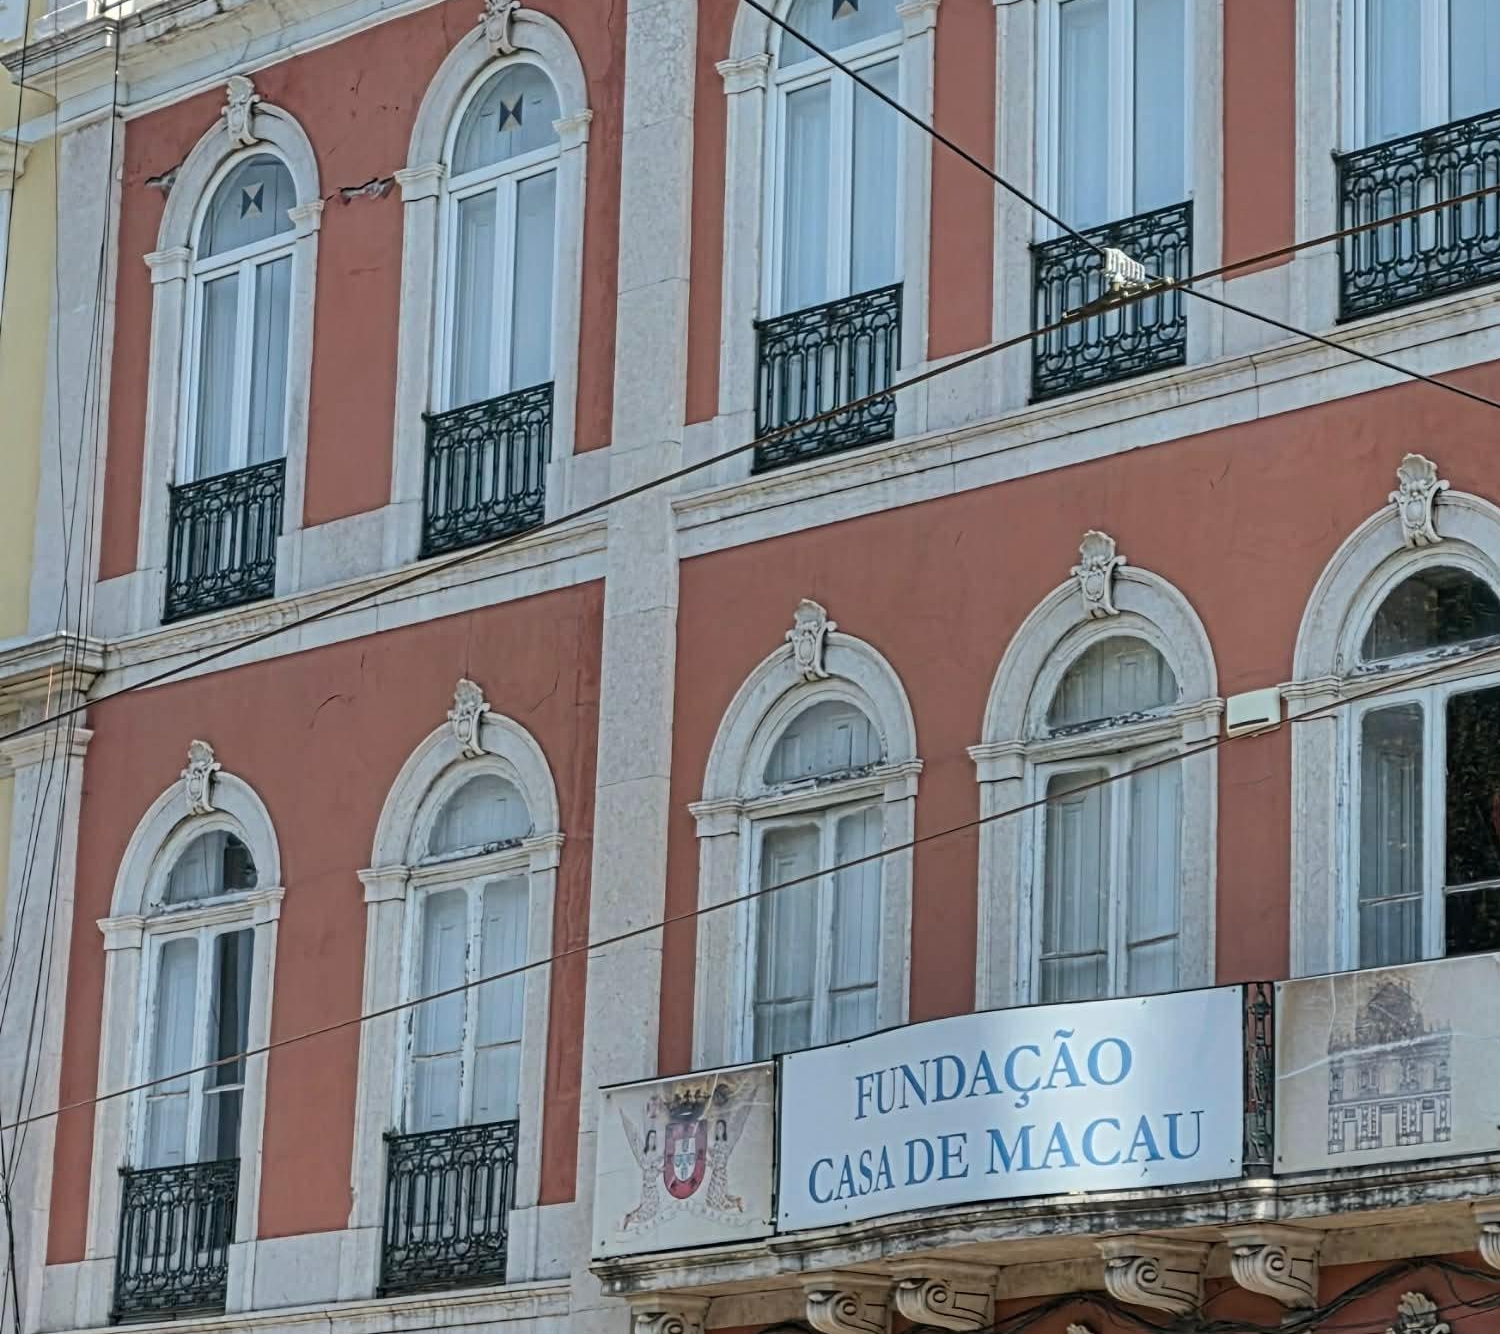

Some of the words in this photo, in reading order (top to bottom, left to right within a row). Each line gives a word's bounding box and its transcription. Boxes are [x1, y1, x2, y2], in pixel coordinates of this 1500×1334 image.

[855, 1028, 1132, 1120] FUNDAÇÃO
[808, 1145, 895, 1204] CASA
[904, 1132, 969, 1186] DE
[985, 1110, 1205, 1174] MACAU
